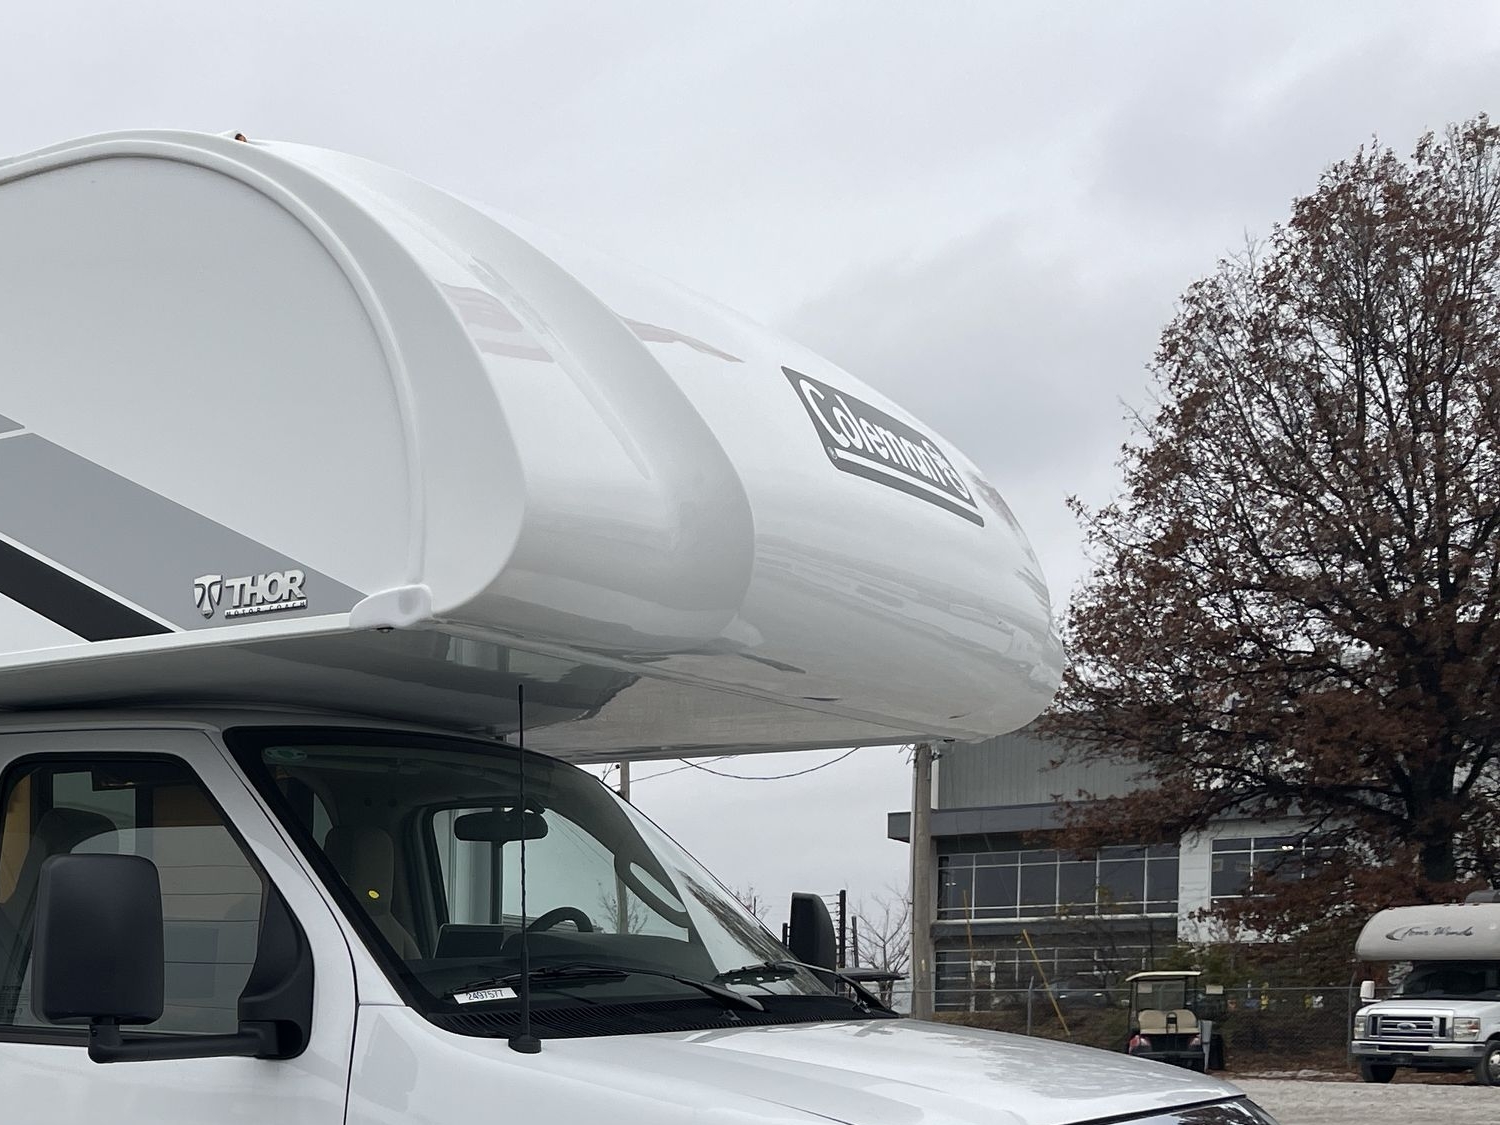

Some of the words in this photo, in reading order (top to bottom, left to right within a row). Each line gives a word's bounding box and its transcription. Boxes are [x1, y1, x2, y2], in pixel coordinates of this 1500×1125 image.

[800, 379, 948, 487] Coleman
[225, 569, 306, 608] THOR
[225, 606, 261, 617] MOTOR
[269, 601, 306, 612] COACH
[468, 989, 504, 1001] 2497577
